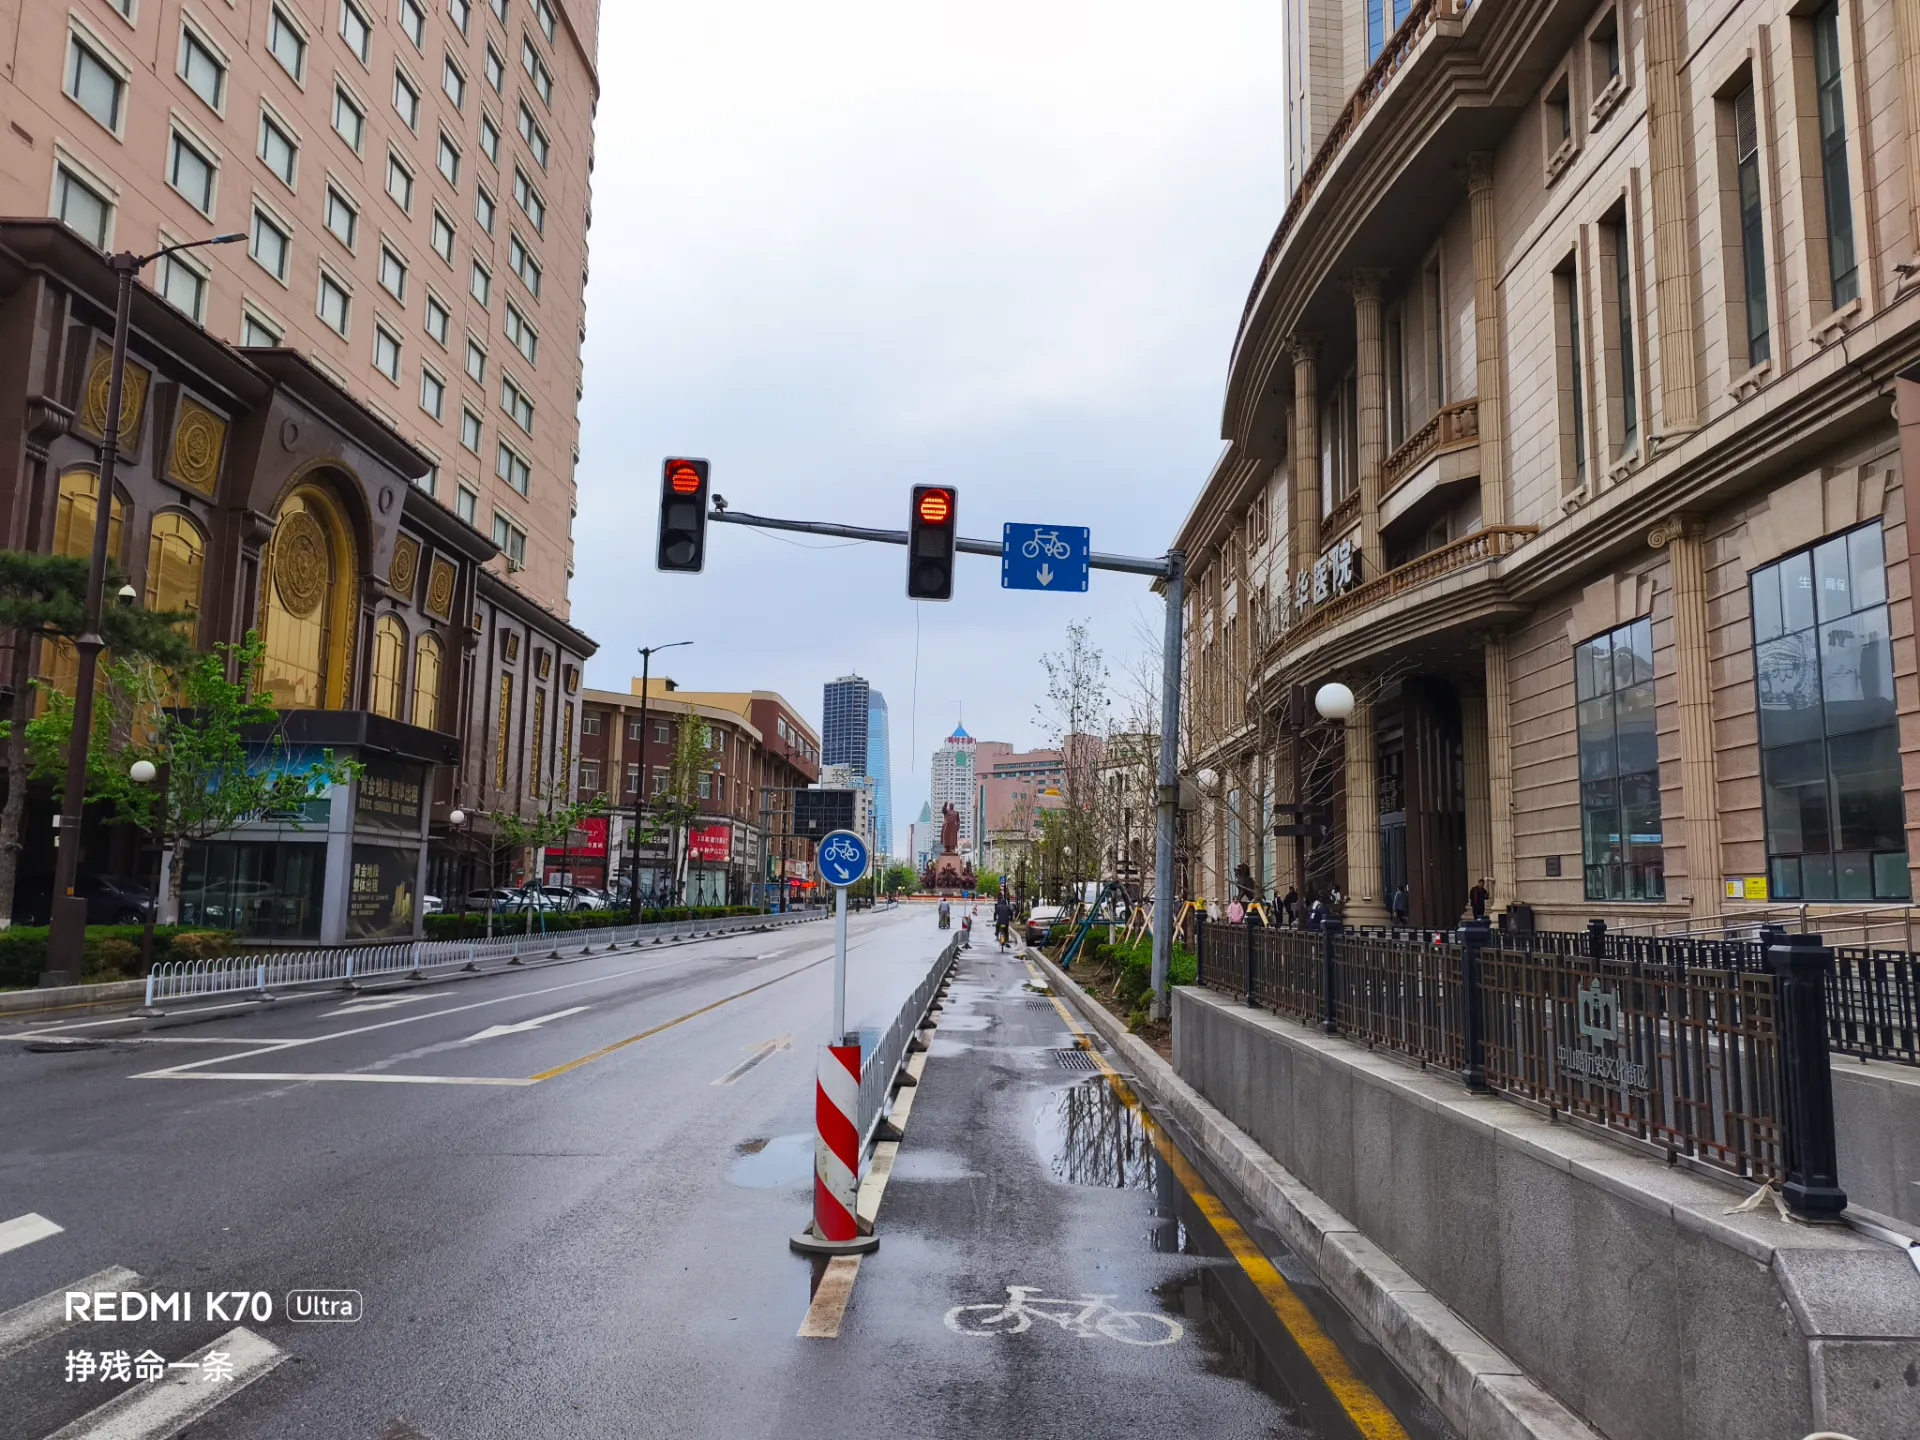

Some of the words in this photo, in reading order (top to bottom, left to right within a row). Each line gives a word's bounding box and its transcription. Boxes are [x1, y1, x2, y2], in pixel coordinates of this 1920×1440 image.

[1825, 577, 1846, 591] 商保
[360, 775, 390, 798] 黄金地段
[353, 863, 380, 878] 黄金地段
[352, 878, 379, 893] 整体出租
[1557, 1044, 1649, 1089] 中山路历史文化街区
